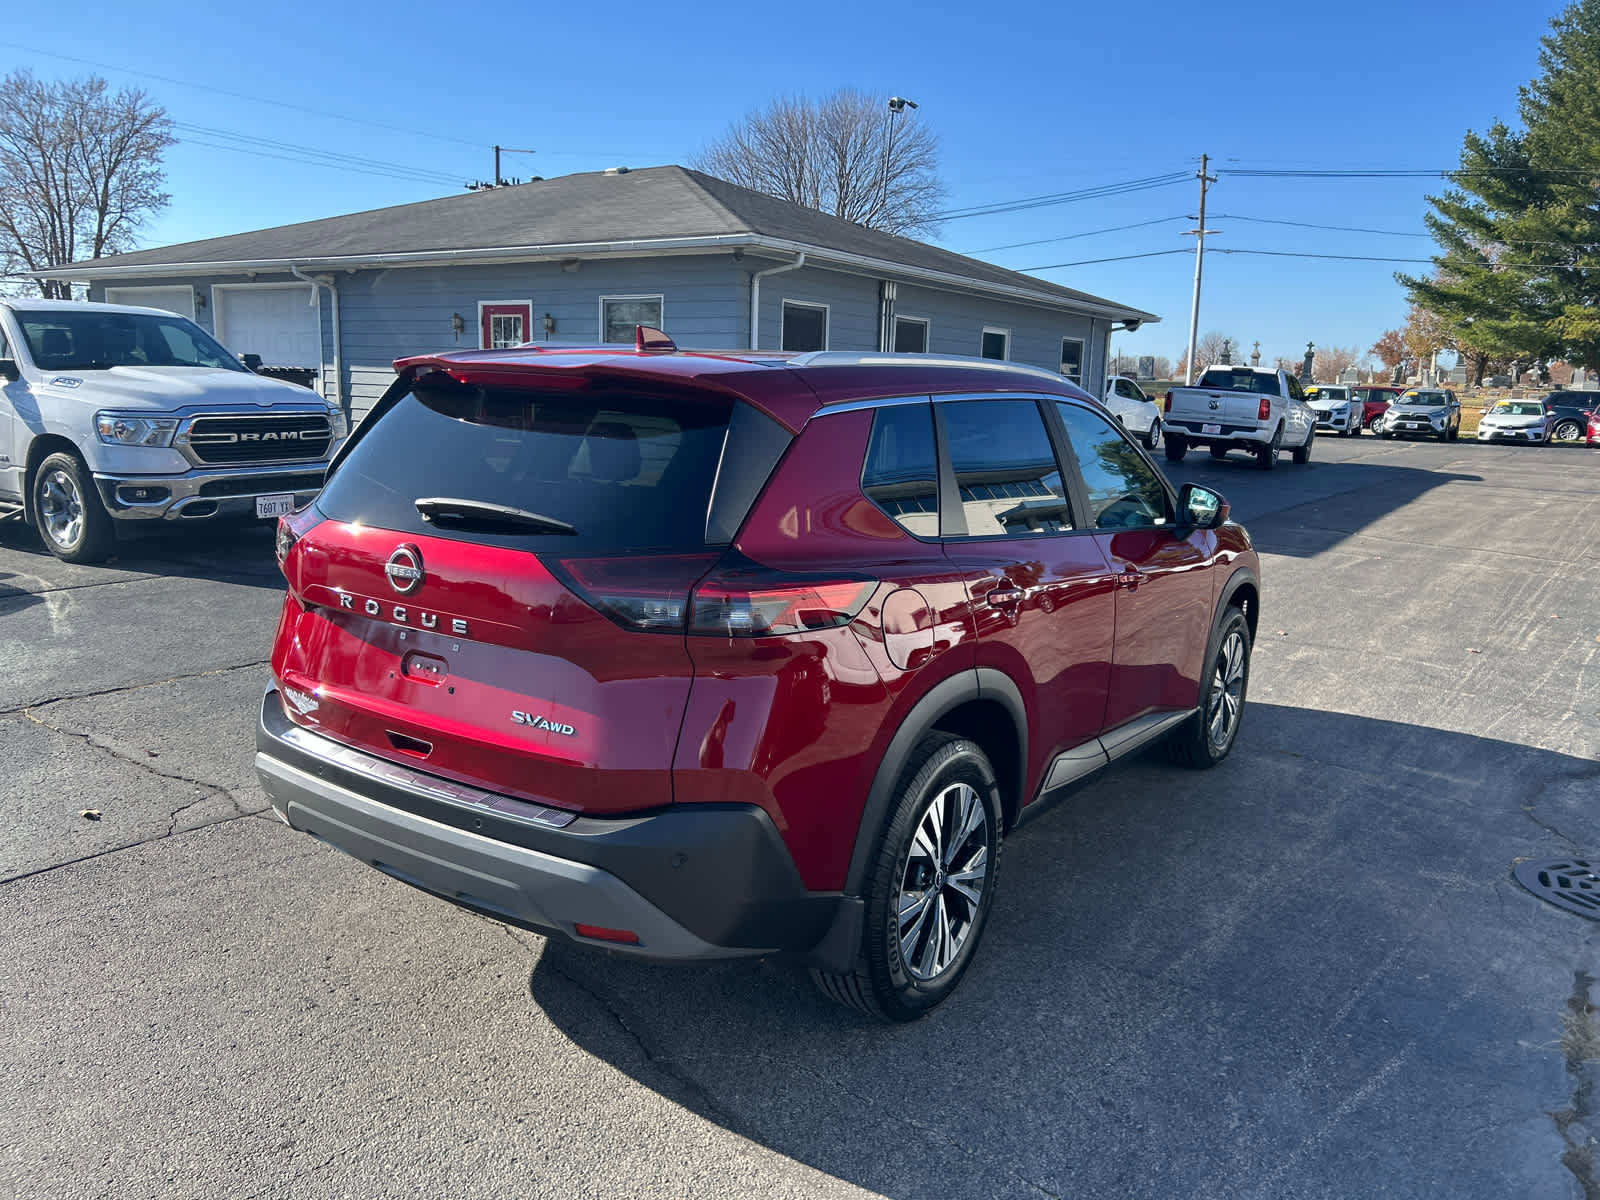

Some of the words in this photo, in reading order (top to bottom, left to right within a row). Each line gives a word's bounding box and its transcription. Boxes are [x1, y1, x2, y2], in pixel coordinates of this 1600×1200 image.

[241, 431, 298, 441] RAM
[385, 557, 421, 578] NISSAN
[340, 593, 468, 635] ROGUE
[510, 710, 543, 727] SV
[539, 719, 576, 736] AWD
